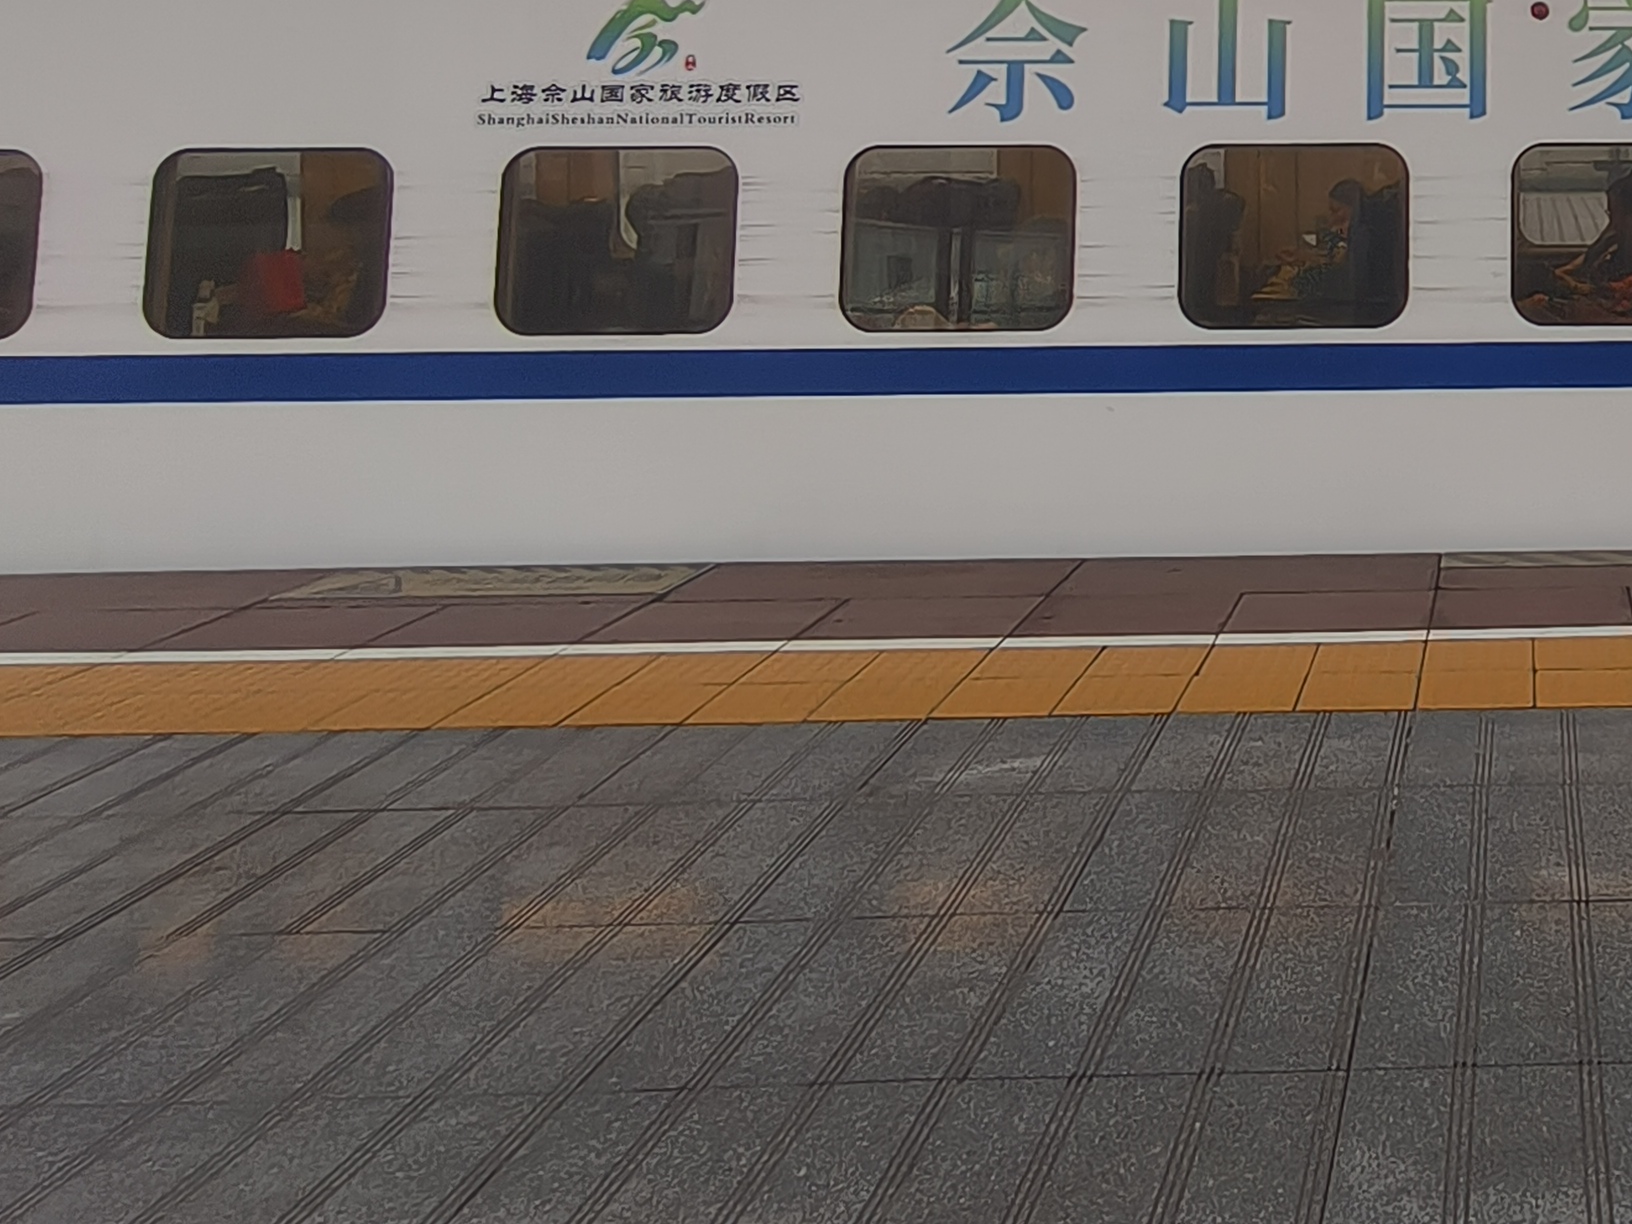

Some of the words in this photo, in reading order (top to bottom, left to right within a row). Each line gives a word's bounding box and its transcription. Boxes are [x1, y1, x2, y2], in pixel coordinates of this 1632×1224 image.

[480, 83, 801, 105] 上海佘山国家旅游度假区
